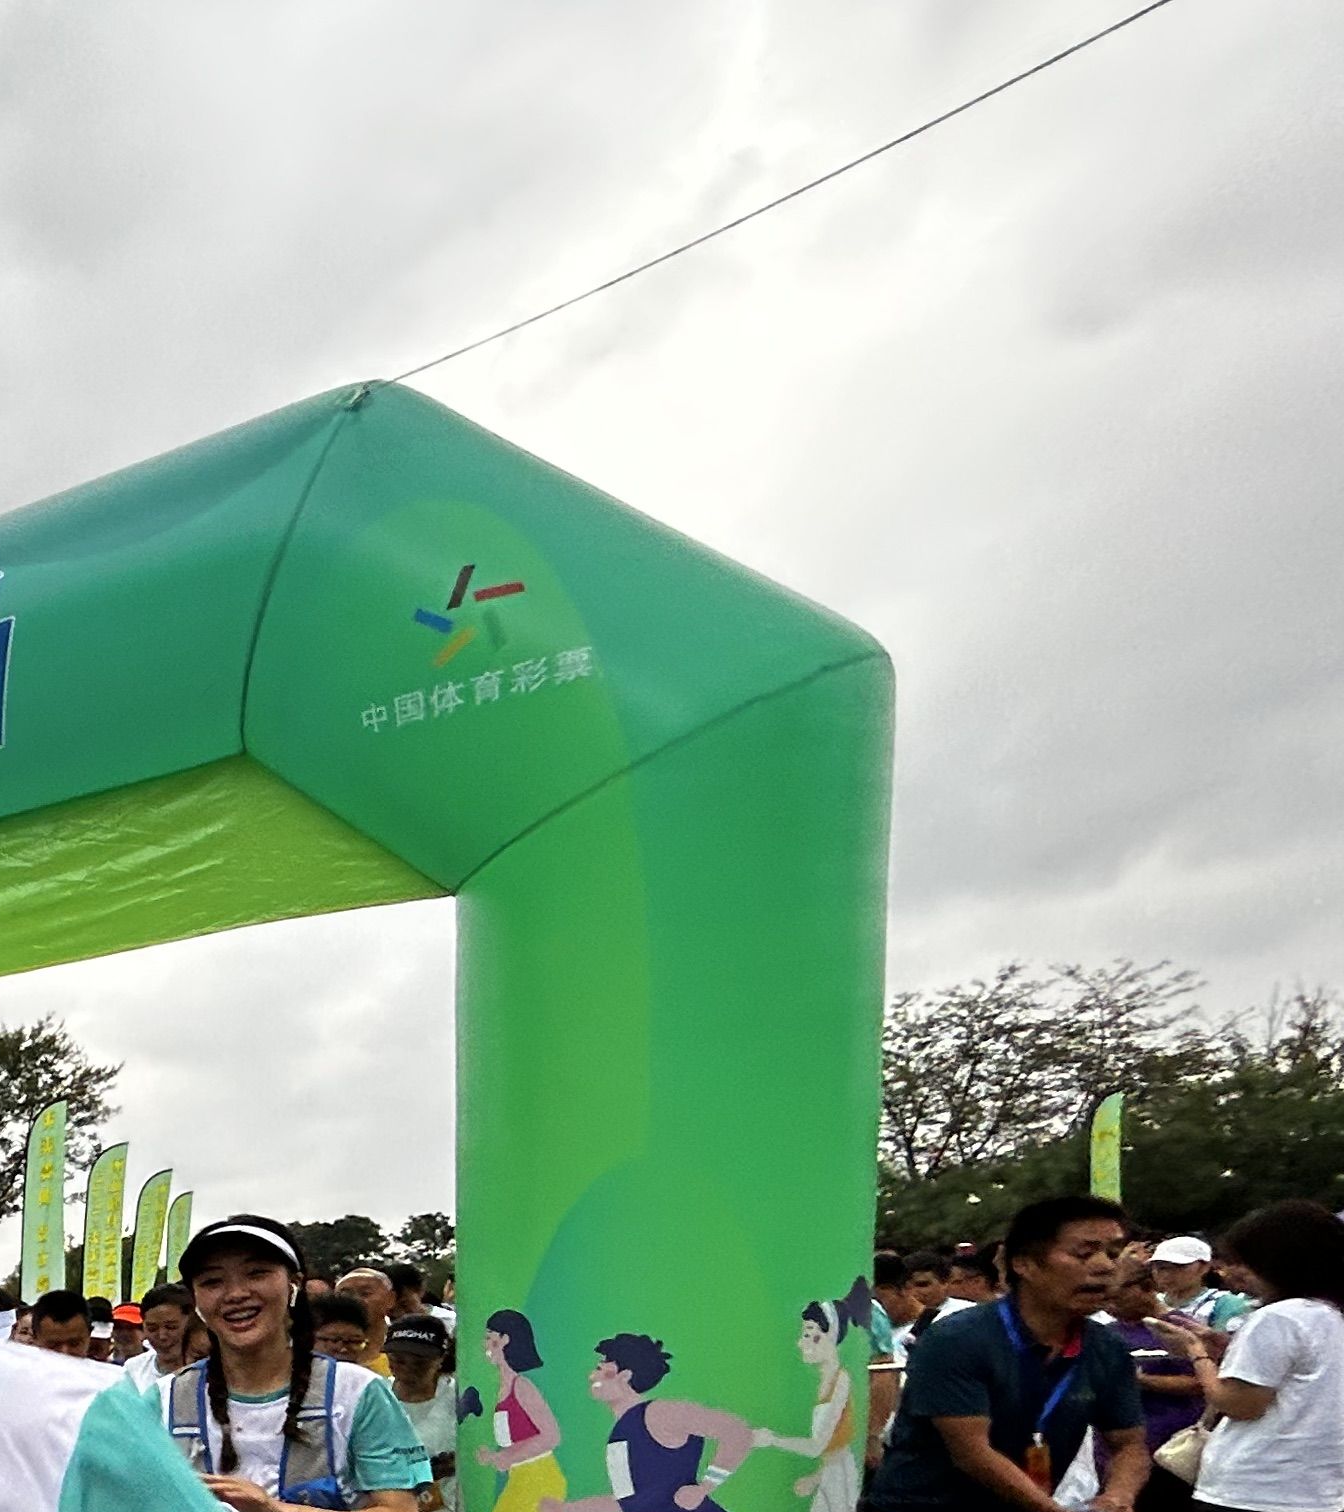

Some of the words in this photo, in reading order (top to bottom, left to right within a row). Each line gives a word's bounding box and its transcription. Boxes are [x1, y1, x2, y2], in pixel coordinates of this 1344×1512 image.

[361, 646, 593, 732] 中国体育彩票
